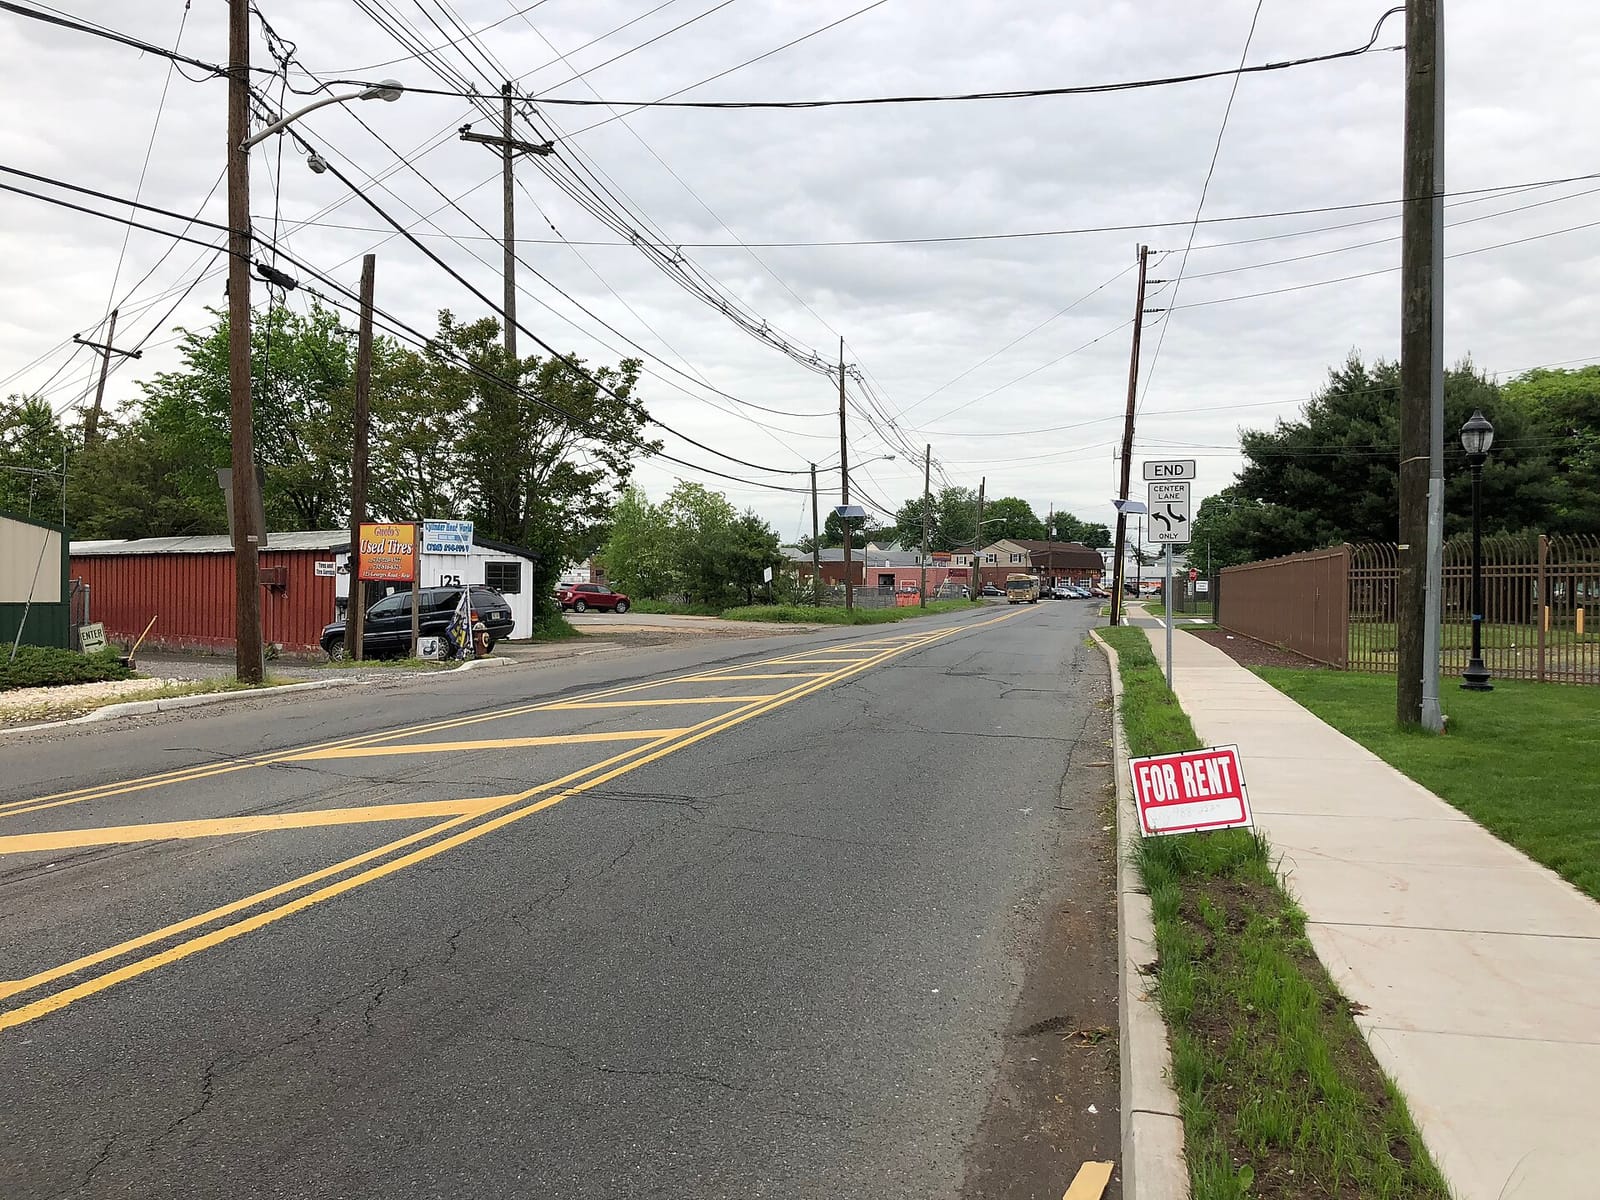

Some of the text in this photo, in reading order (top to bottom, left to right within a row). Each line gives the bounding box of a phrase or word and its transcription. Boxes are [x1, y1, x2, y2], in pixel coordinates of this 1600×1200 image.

[1154, 464, 1184, 477] END
[360, 539, 414, 555] Used Tires
[440, 574, 461, 587] 125
[81, 629, 103, 641] ENTER
[1139, 756, 1233, 803] FOR RENT
